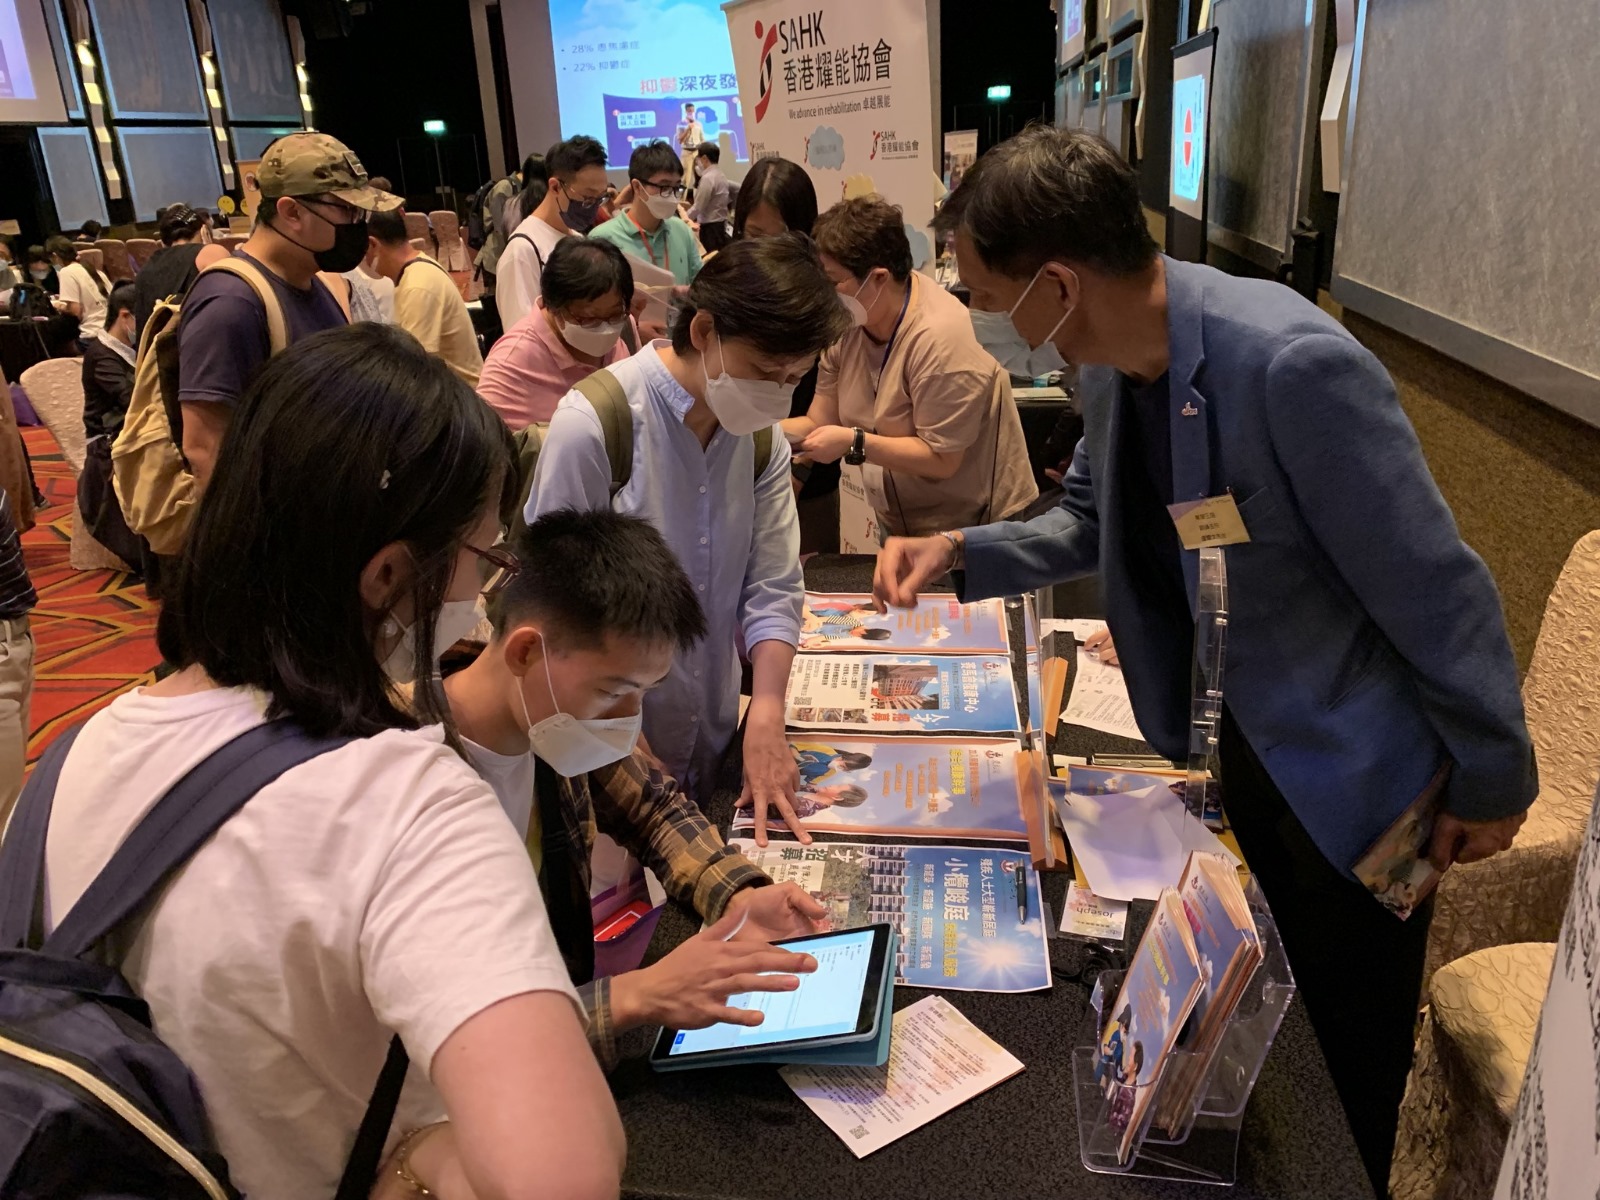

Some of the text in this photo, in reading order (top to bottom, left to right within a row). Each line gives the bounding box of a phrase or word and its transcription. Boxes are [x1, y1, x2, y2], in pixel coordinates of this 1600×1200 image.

[778, 9, 826, 54] SAHK
[571, 43, 594, 53] 28%
[573, 62, 595, 72] 22%
[783, 37, 892, 95] 香港耀能協會
[818, 104, 825, 116] in
[824, 101, 862, 115] rehabilitation
[880, 130, 897, 141] SAHK
[780, 846, 879, 864] 人才招募
[1076, 906, 1114, 919] Joseph
